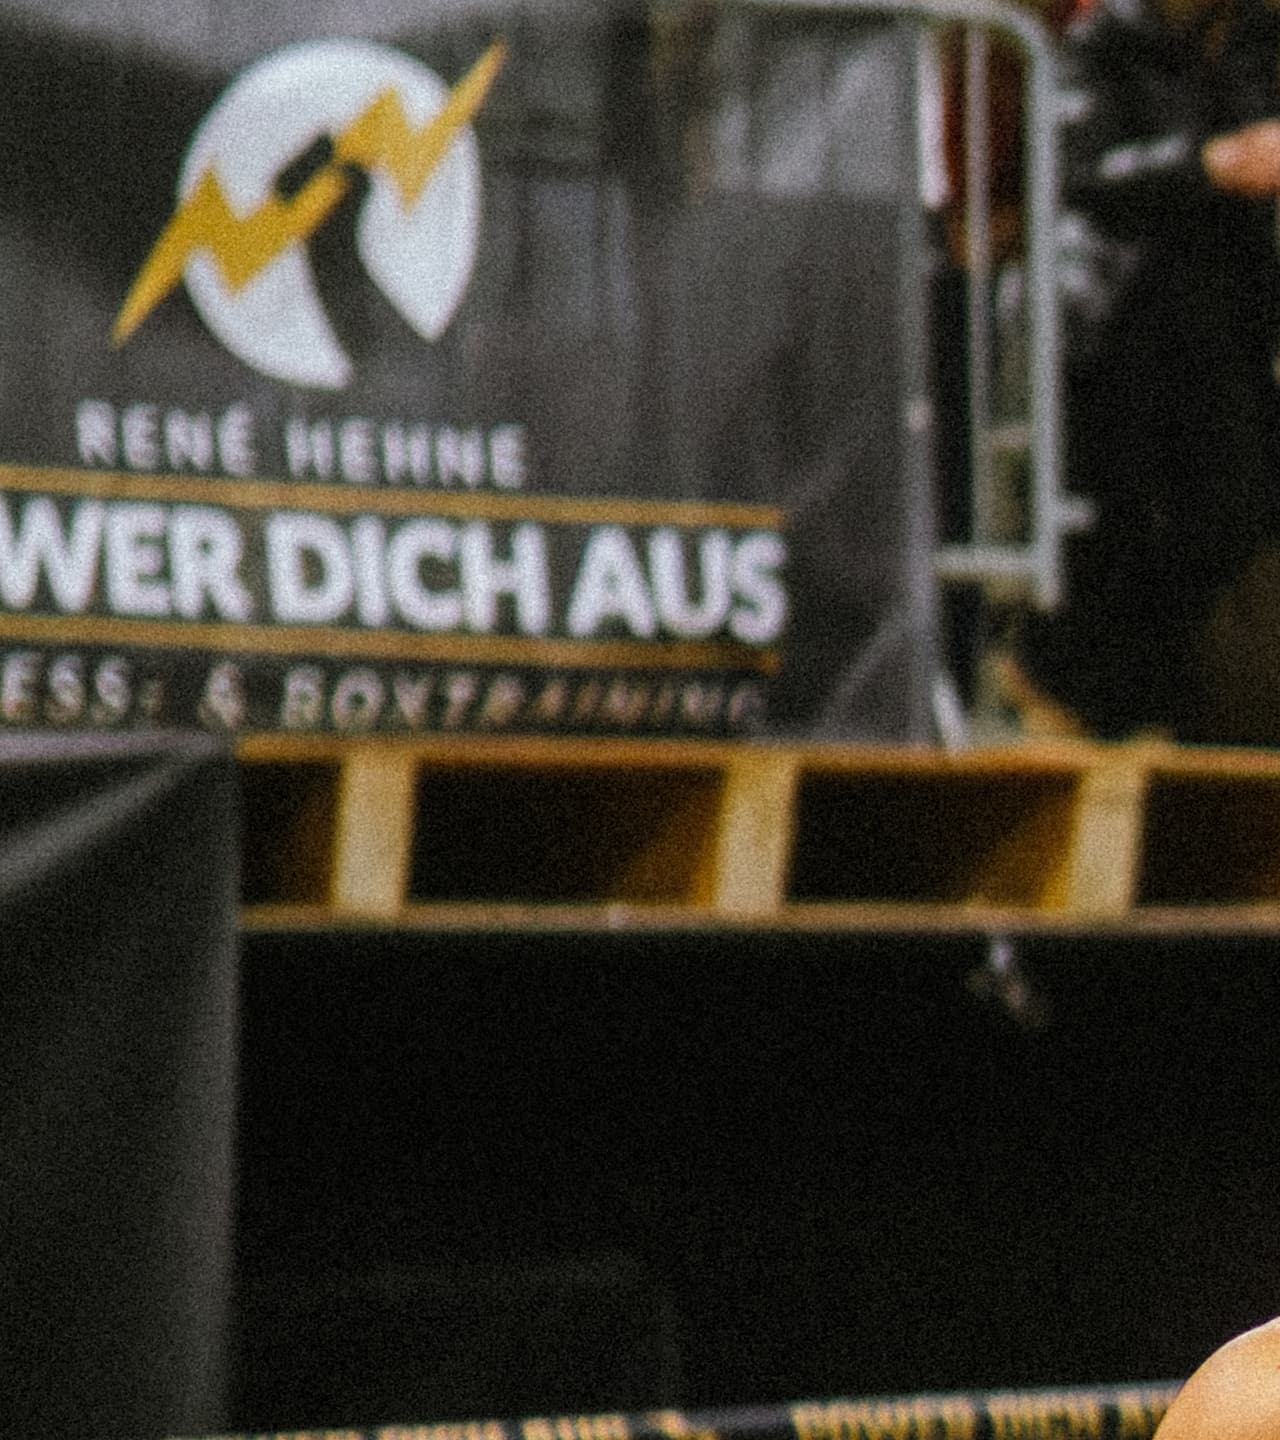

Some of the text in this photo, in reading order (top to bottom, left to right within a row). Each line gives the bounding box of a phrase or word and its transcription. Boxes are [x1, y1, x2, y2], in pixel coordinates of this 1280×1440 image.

[75, 397, 527, 488] RENÉ HEHNE
[265, 509, 548, 636] DICH
[568, 525, 787, 644] AUS
